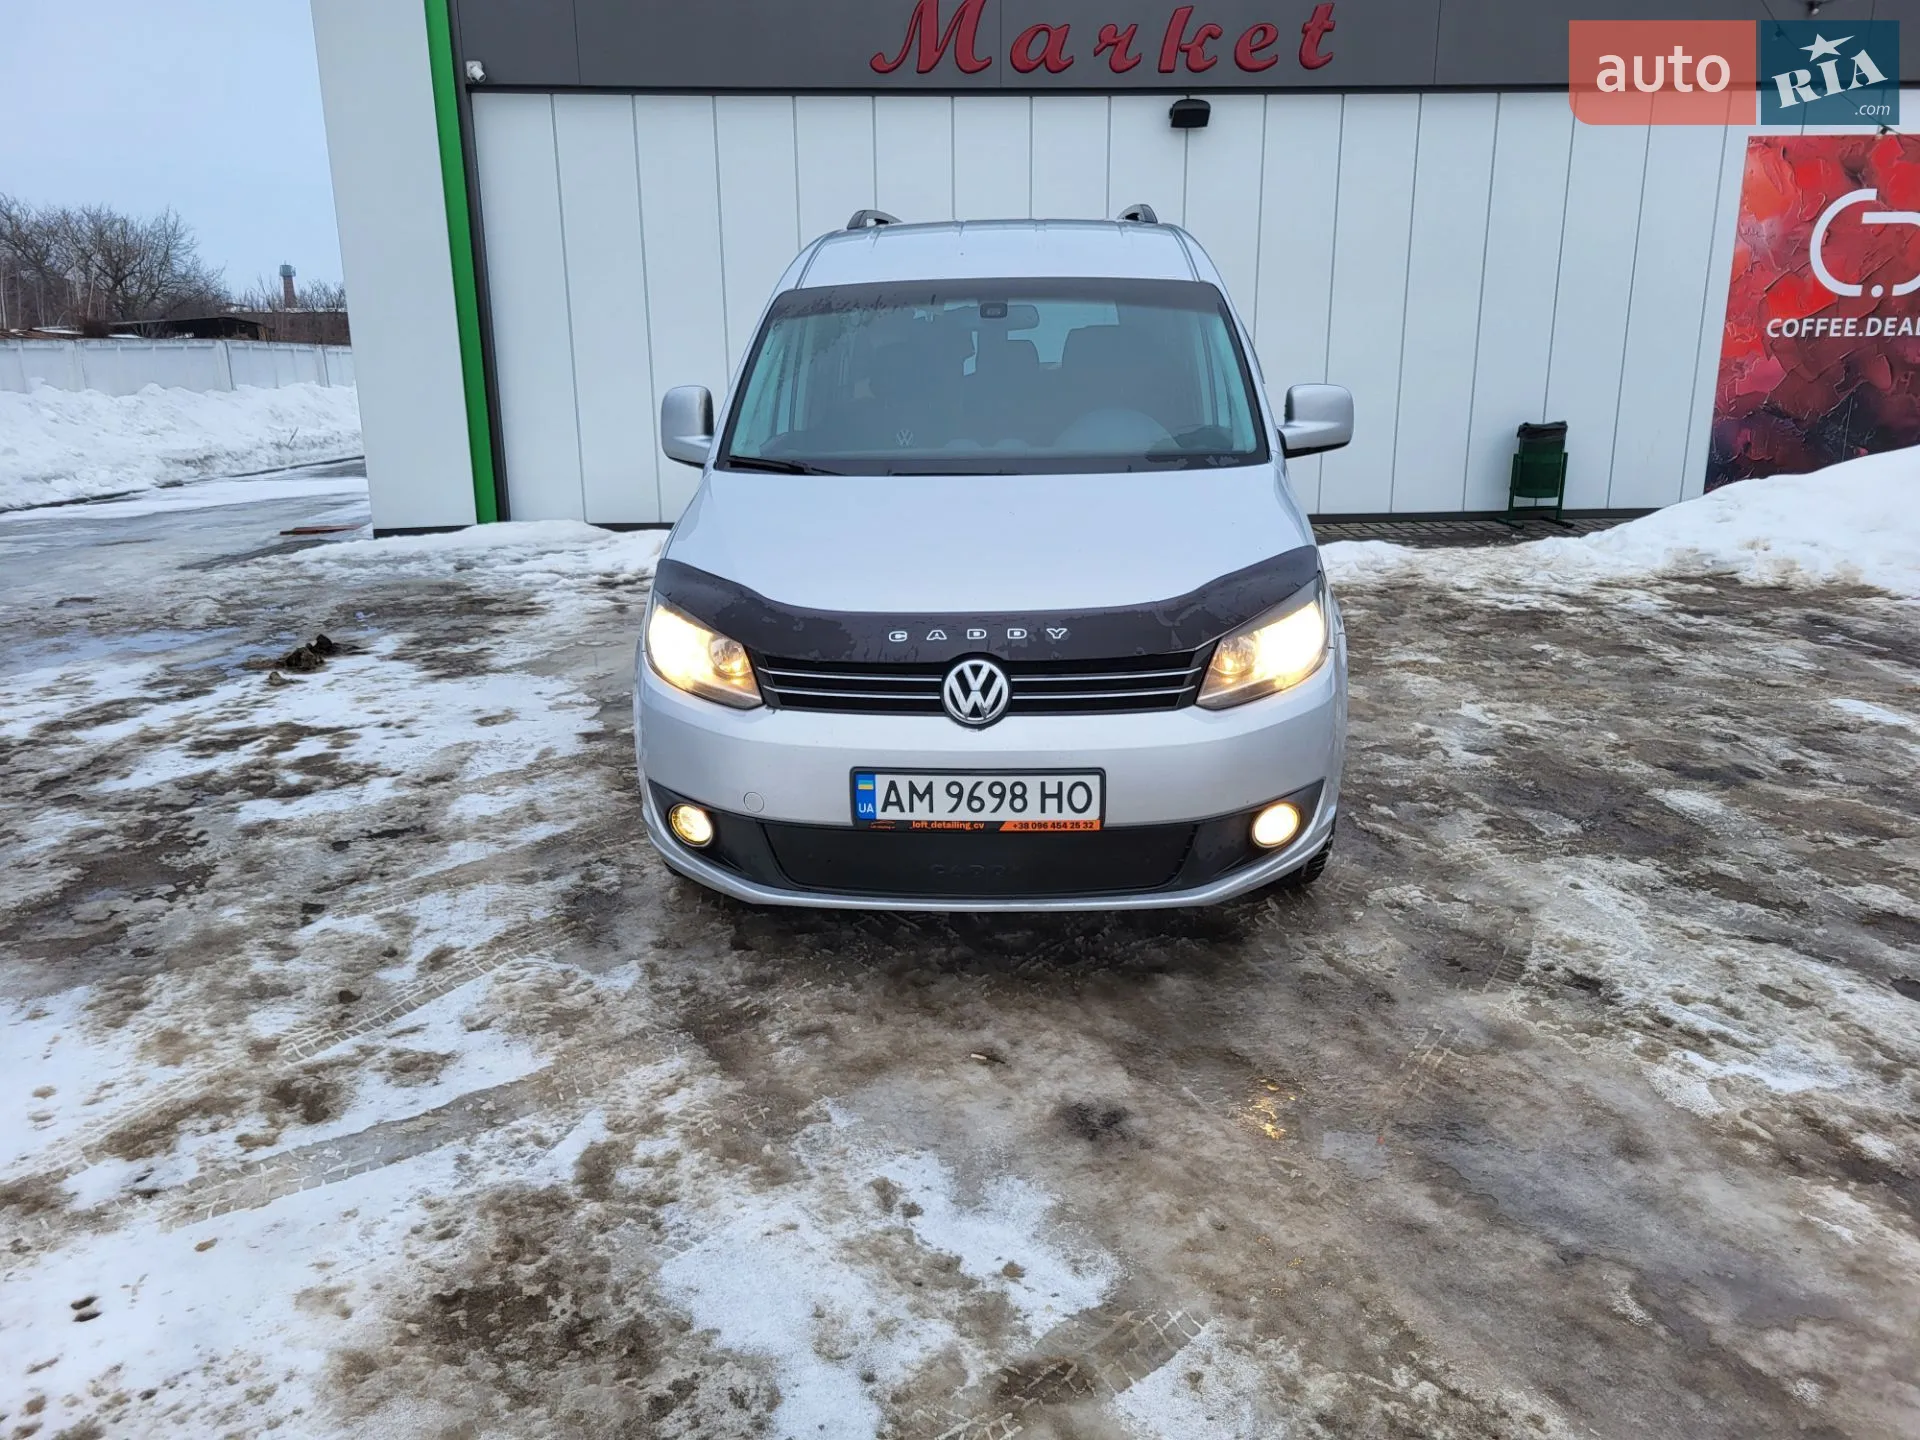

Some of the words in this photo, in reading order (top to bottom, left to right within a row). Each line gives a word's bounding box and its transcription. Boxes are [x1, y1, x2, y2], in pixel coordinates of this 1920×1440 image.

[869, 0, 1335, 74] Market
[888, 627, 1068, 642] CADDY
[880, 780, 935, 814] AM
[945, 781, 1029, 814] 9698
[1040, 781, 1093, 814] HO
[858, 803, 874, 814] UA
[1012, 821, 1029, 830] +38
[1031, 821, 1049, 830] 096
[1050, 821, 1068, 830] 454
[1082, 821, 1095, 830] 32
